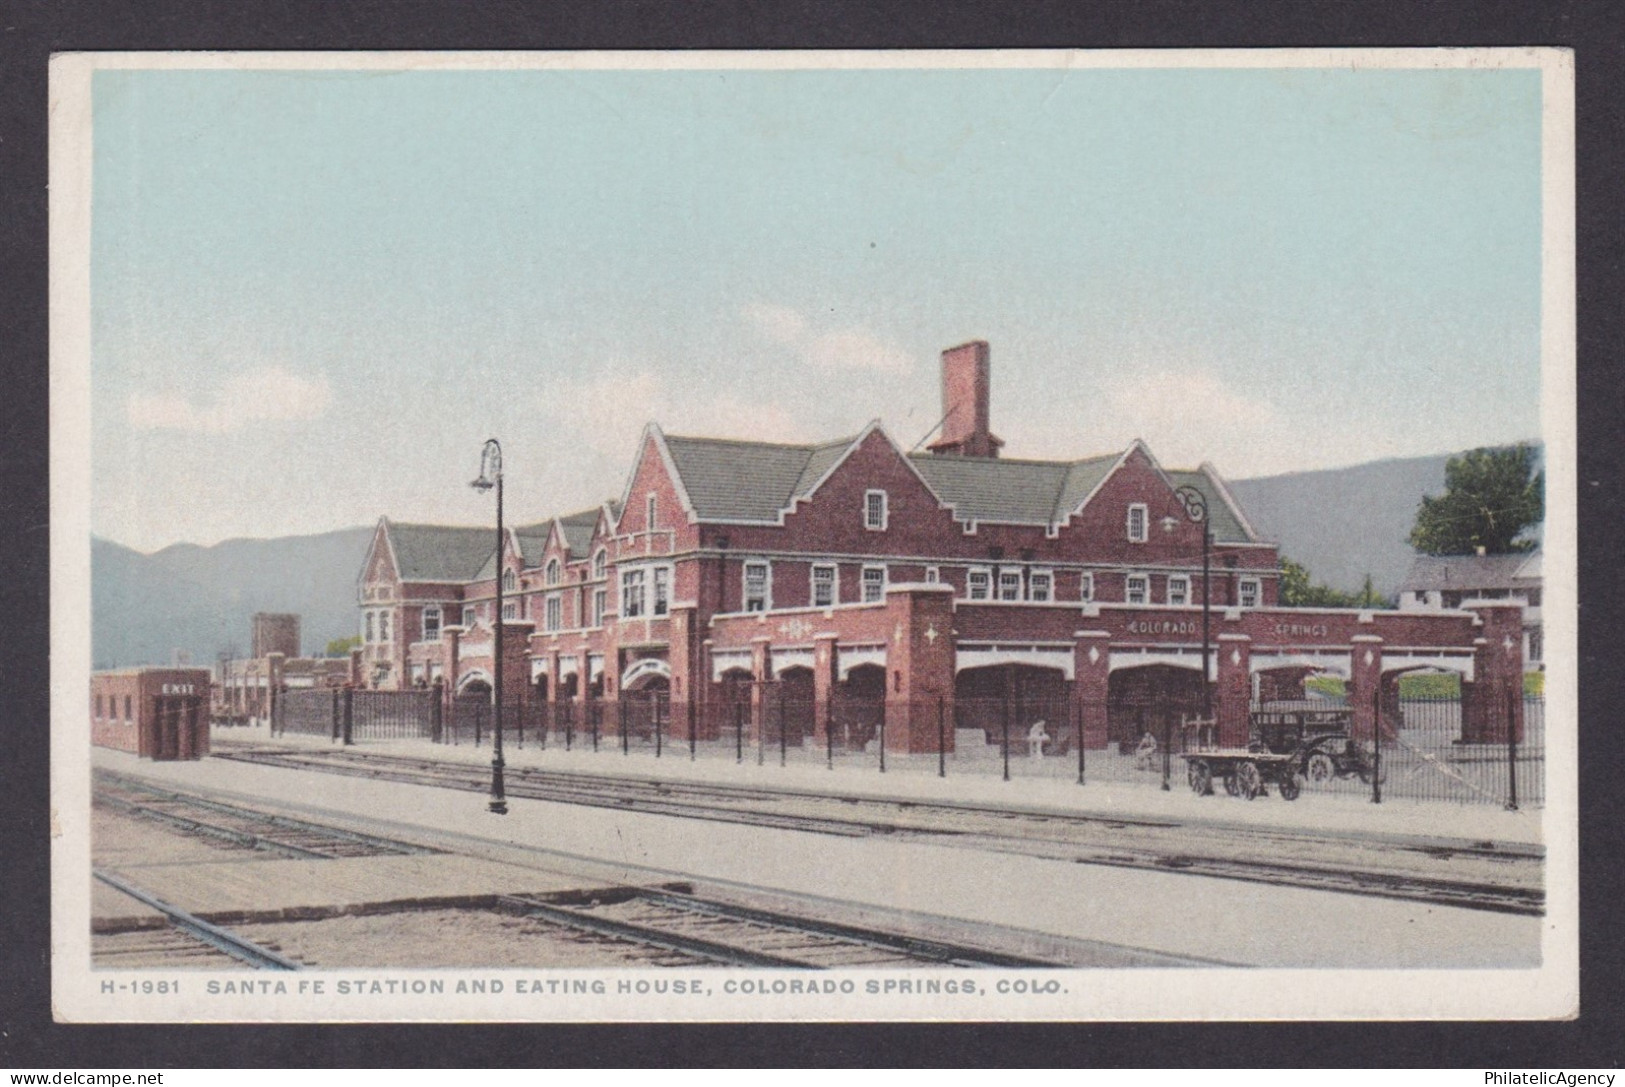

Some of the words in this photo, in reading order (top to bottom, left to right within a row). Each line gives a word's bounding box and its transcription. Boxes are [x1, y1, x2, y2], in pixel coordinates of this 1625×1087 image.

[1130, 621, 1196, 635] COLORADO
[1276, 623, 1328, 637] SPRINGS
[162, 683, 195, 695] EXIT
[100, 980, 181, 994] H-1981
[206, 980, 287, 994] SANTA
[299, 980, 326, 994] FE
[334, 980, 445, 994] STATION
[456, 980, 504, 994] AND
[515, 980, 605, 994] EATING
[618, 980, 712, 996] HOUSE,
[724, 979, 855, 994] COLORADO
[866, 979, 986, 996] SPRINGS,
[996, 979, 1070, 994] COLO.
